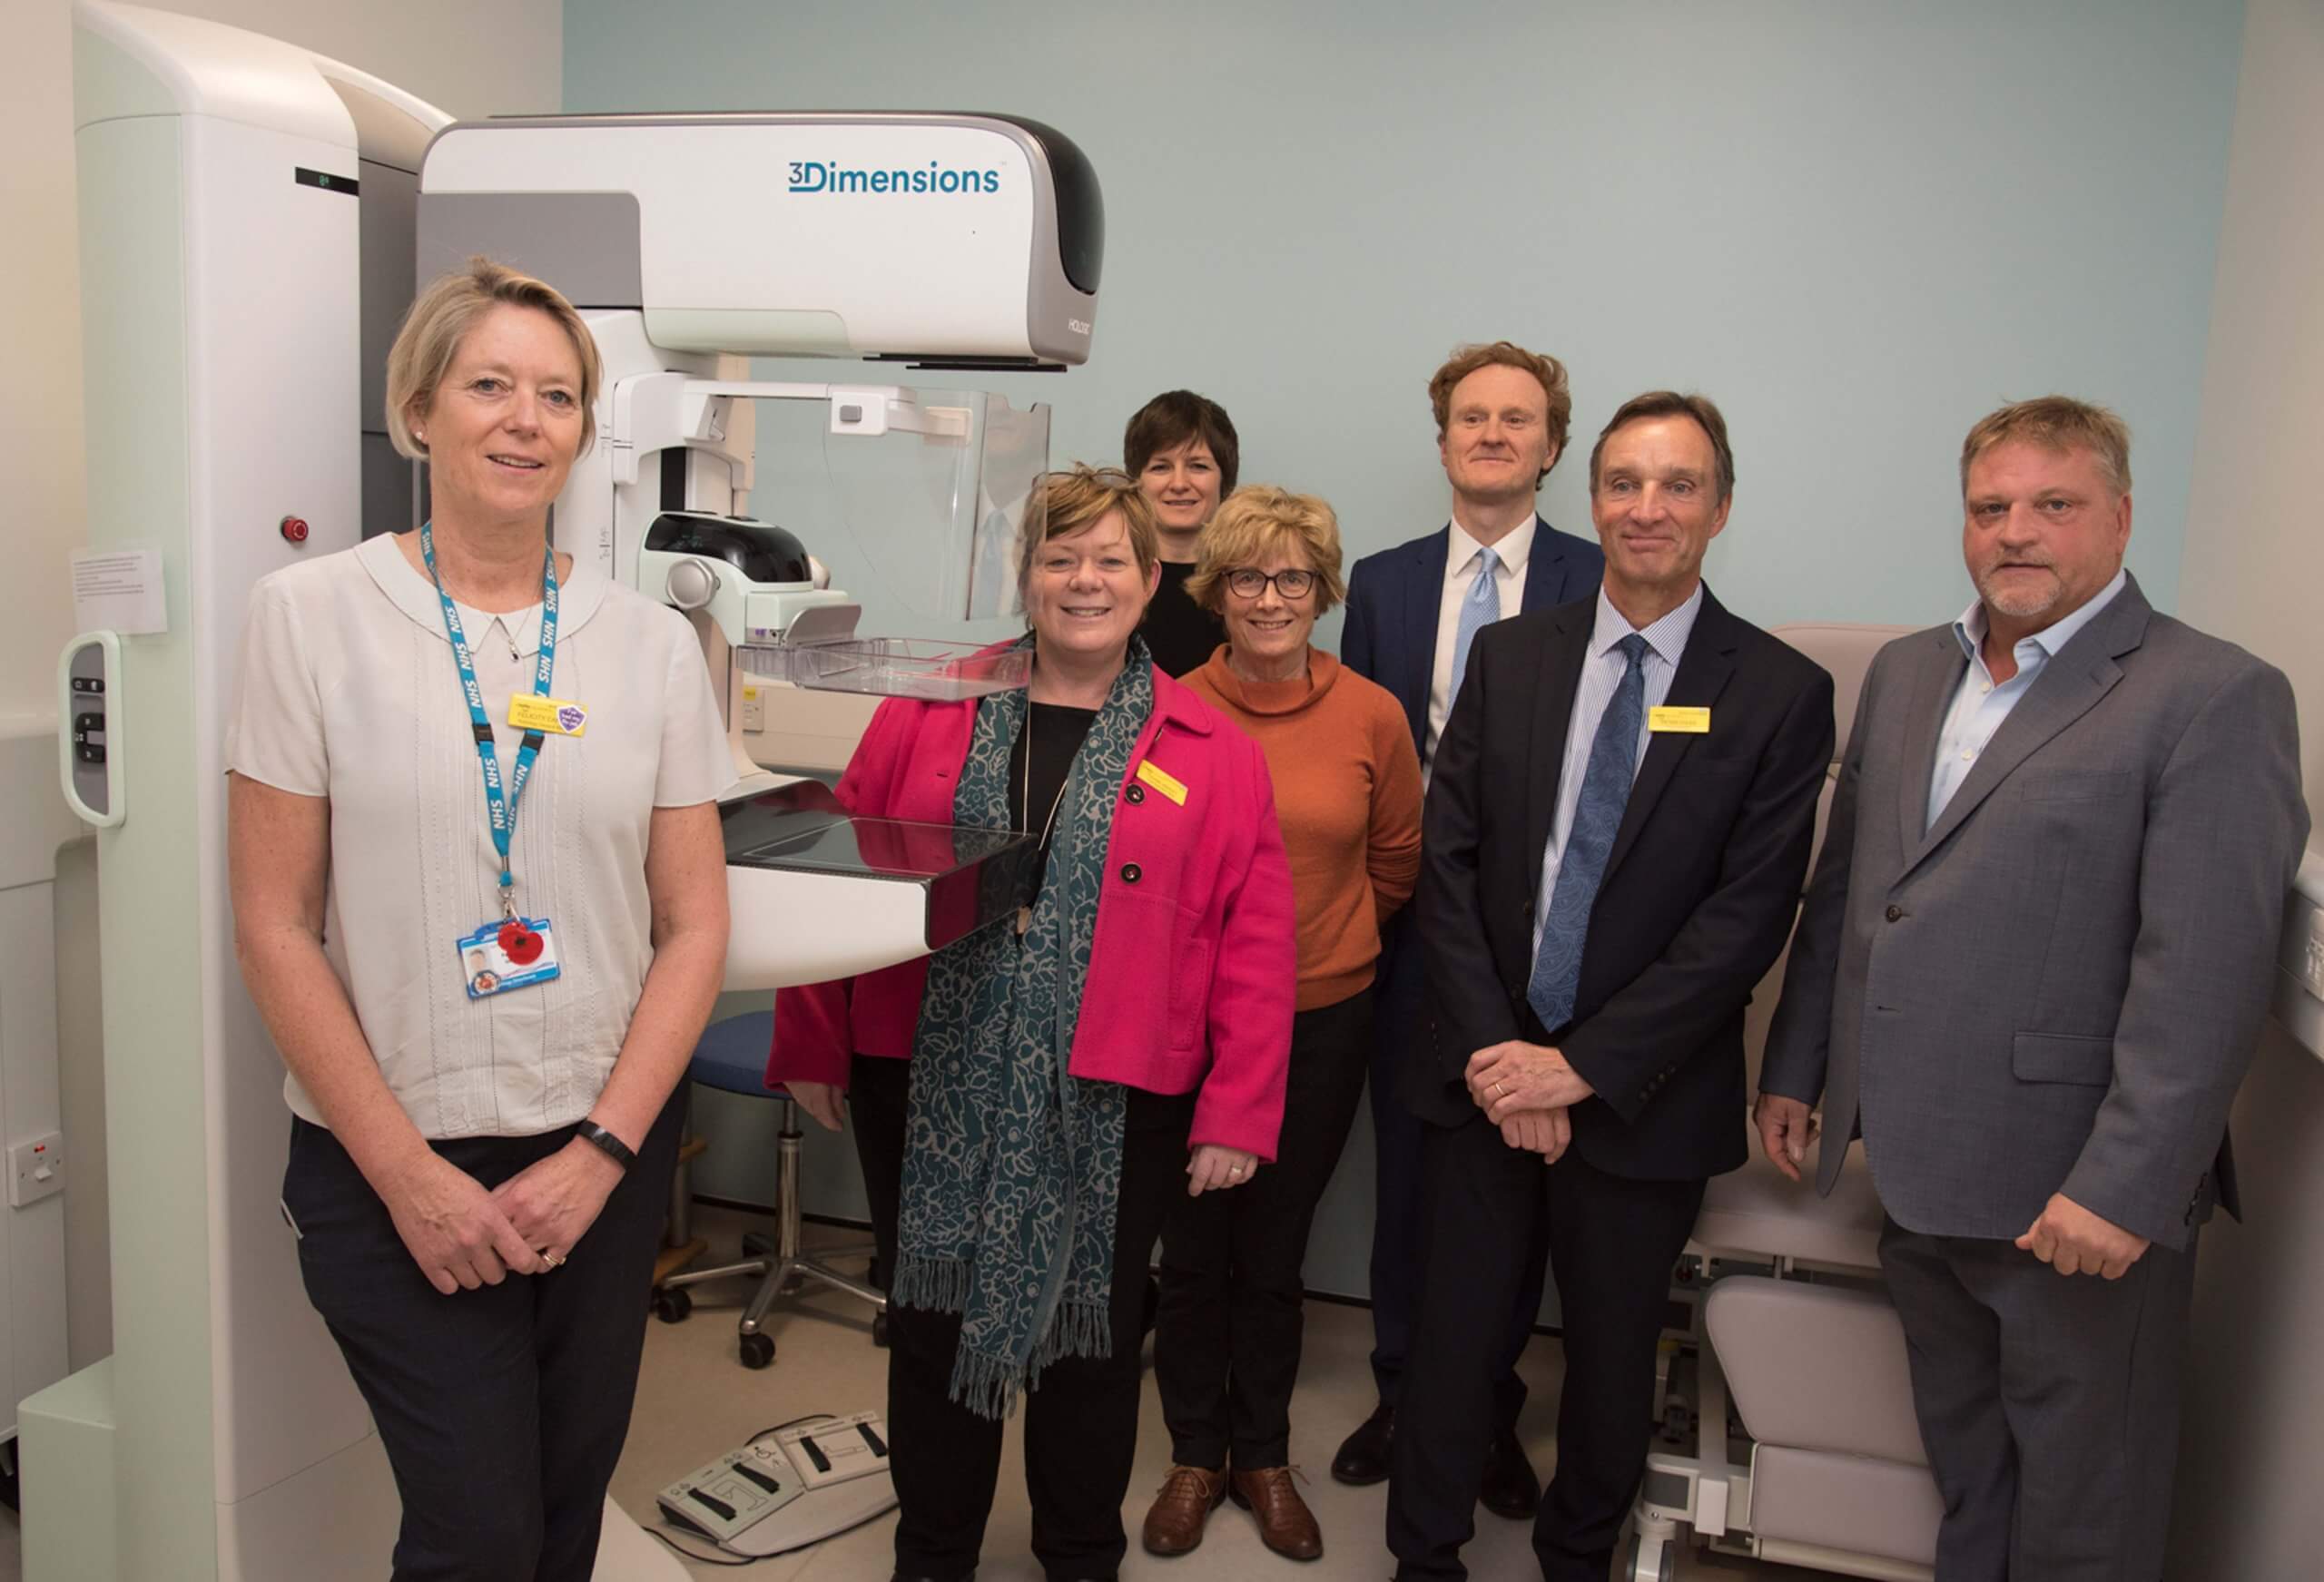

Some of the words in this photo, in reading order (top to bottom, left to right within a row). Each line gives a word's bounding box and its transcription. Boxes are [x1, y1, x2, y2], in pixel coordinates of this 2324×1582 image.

[788, 161, 1000, 193] 3Dimensions
[546, 587, 556, 613] NHS
[445, 606, 461, 634] NHS
[542, 620, 555, 648] NHS
[455, 643, 472, 670] NHS
[538, 655, 551, 683] NHS
[465, 680, 482, 708] NHS
[485, 758, 500, 788] NHS
[490, 799, 506, 830] NHS
